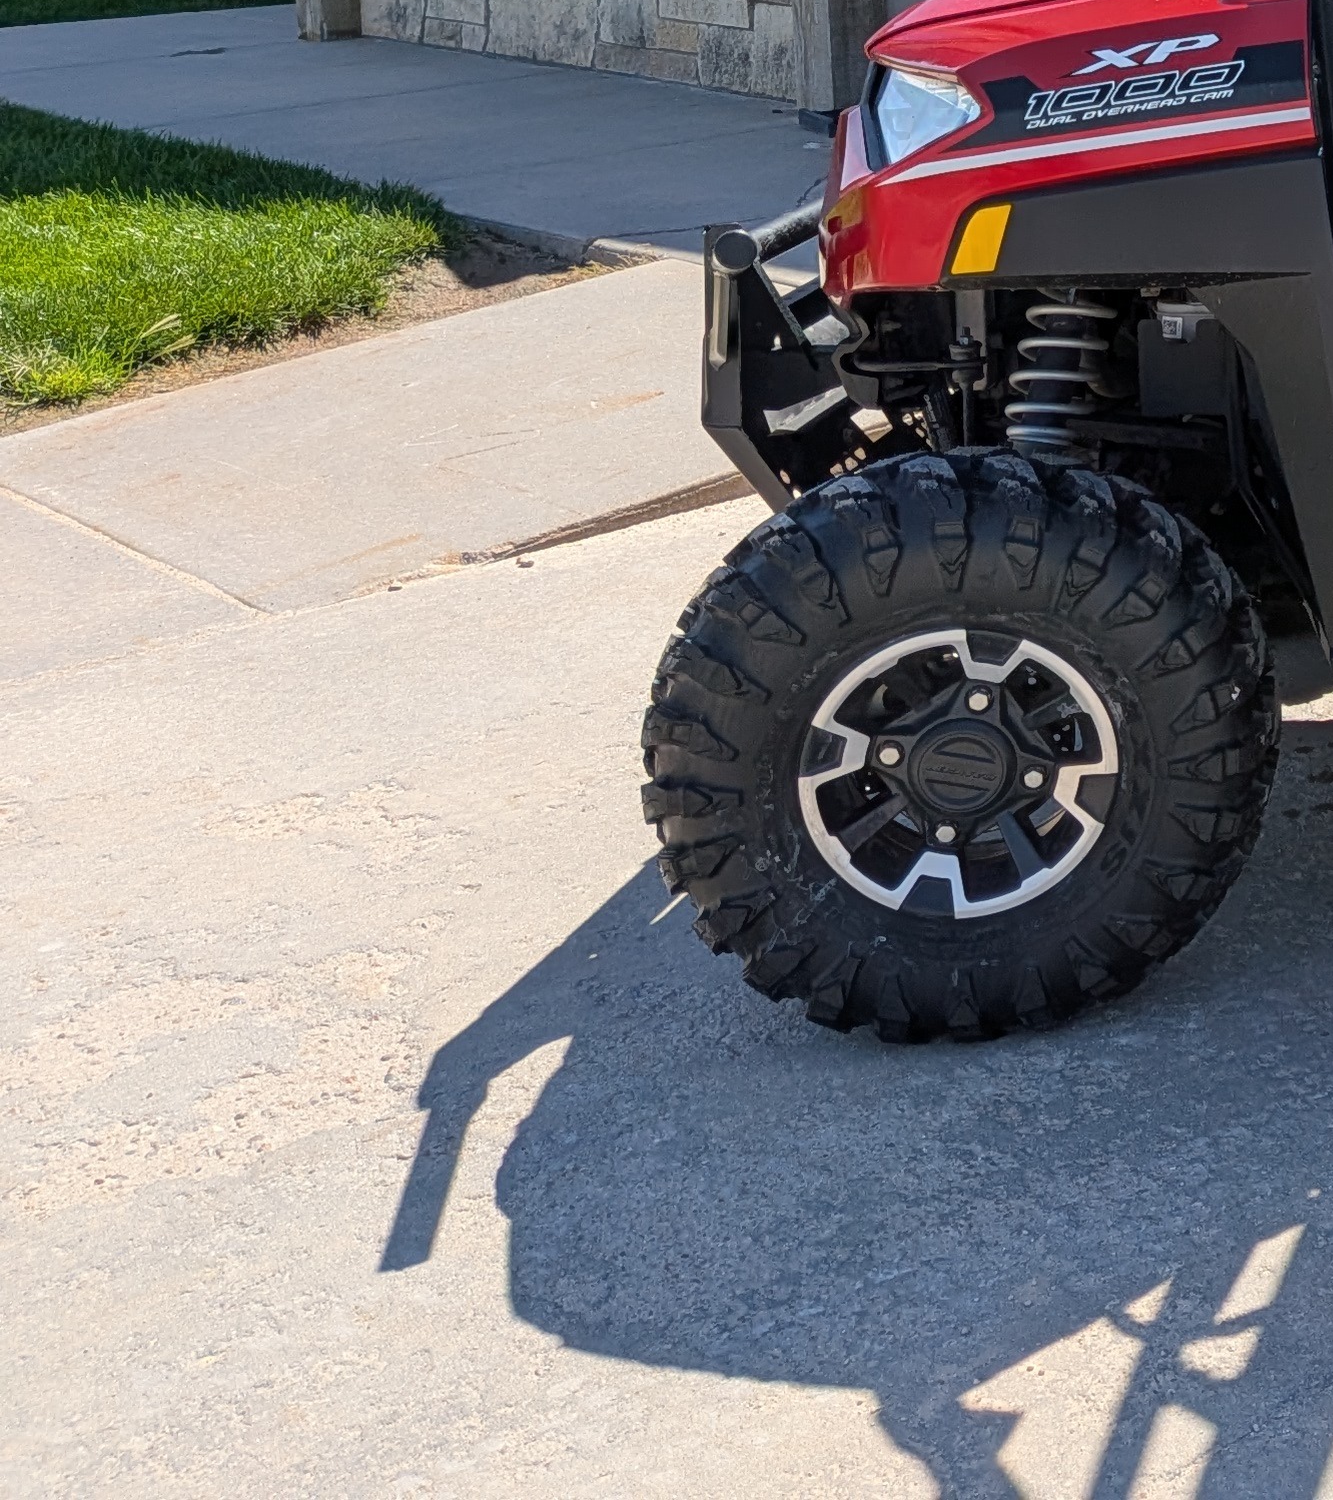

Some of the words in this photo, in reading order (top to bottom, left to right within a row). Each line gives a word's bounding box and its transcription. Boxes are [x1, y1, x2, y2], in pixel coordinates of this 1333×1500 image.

[1071, 33, 1221, 77] XP
[1024, 59, 1245, 120] 1000
[1026, 114, 1077, 130] DUAL
[1081, 96, 1187, 121] OVERHEAD
[1189, 88, 1235, 104] CAM
